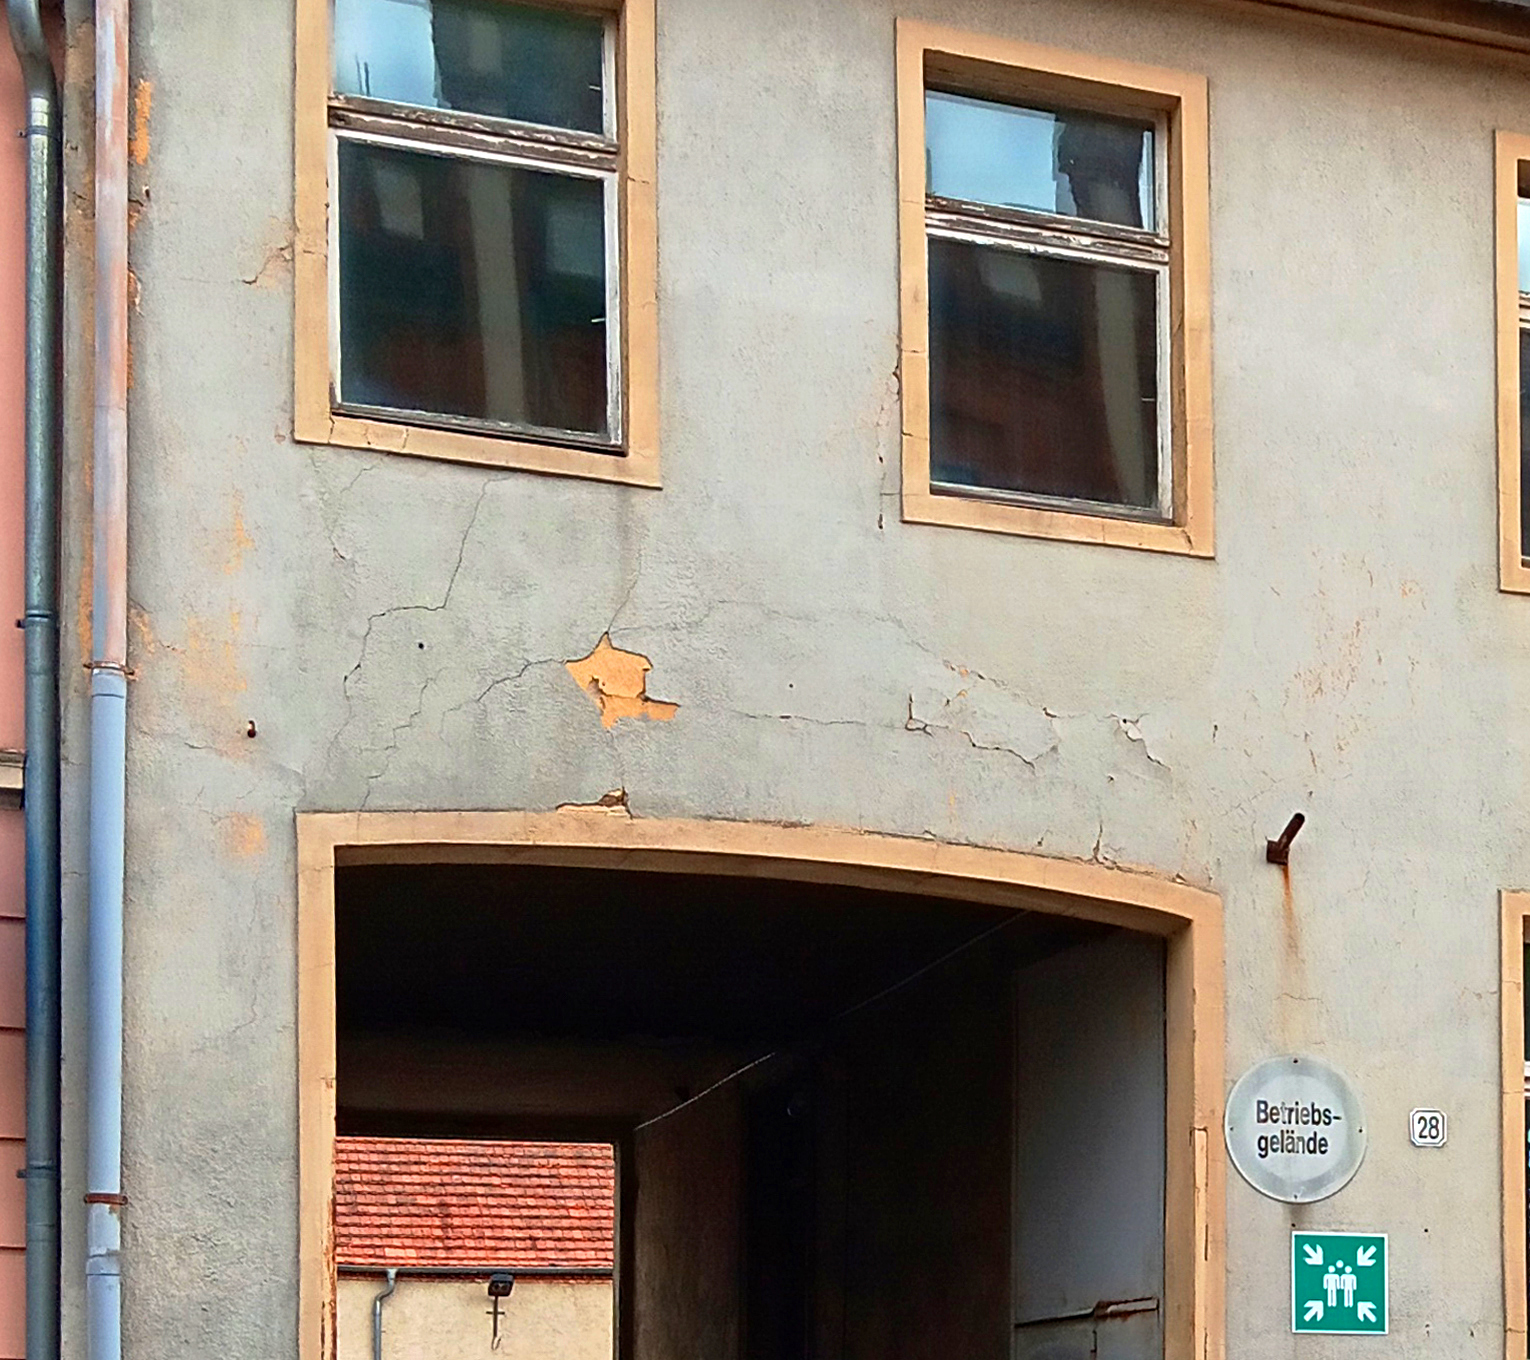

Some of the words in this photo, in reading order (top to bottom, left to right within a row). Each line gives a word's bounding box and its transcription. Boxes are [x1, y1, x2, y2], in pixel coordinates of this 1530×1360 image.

[1256, 1099, 1342, 1126] Betriebs-
[1417, 1116, 1440, 1140] 28
[1257, 1130, 1329, 1158] gelände
